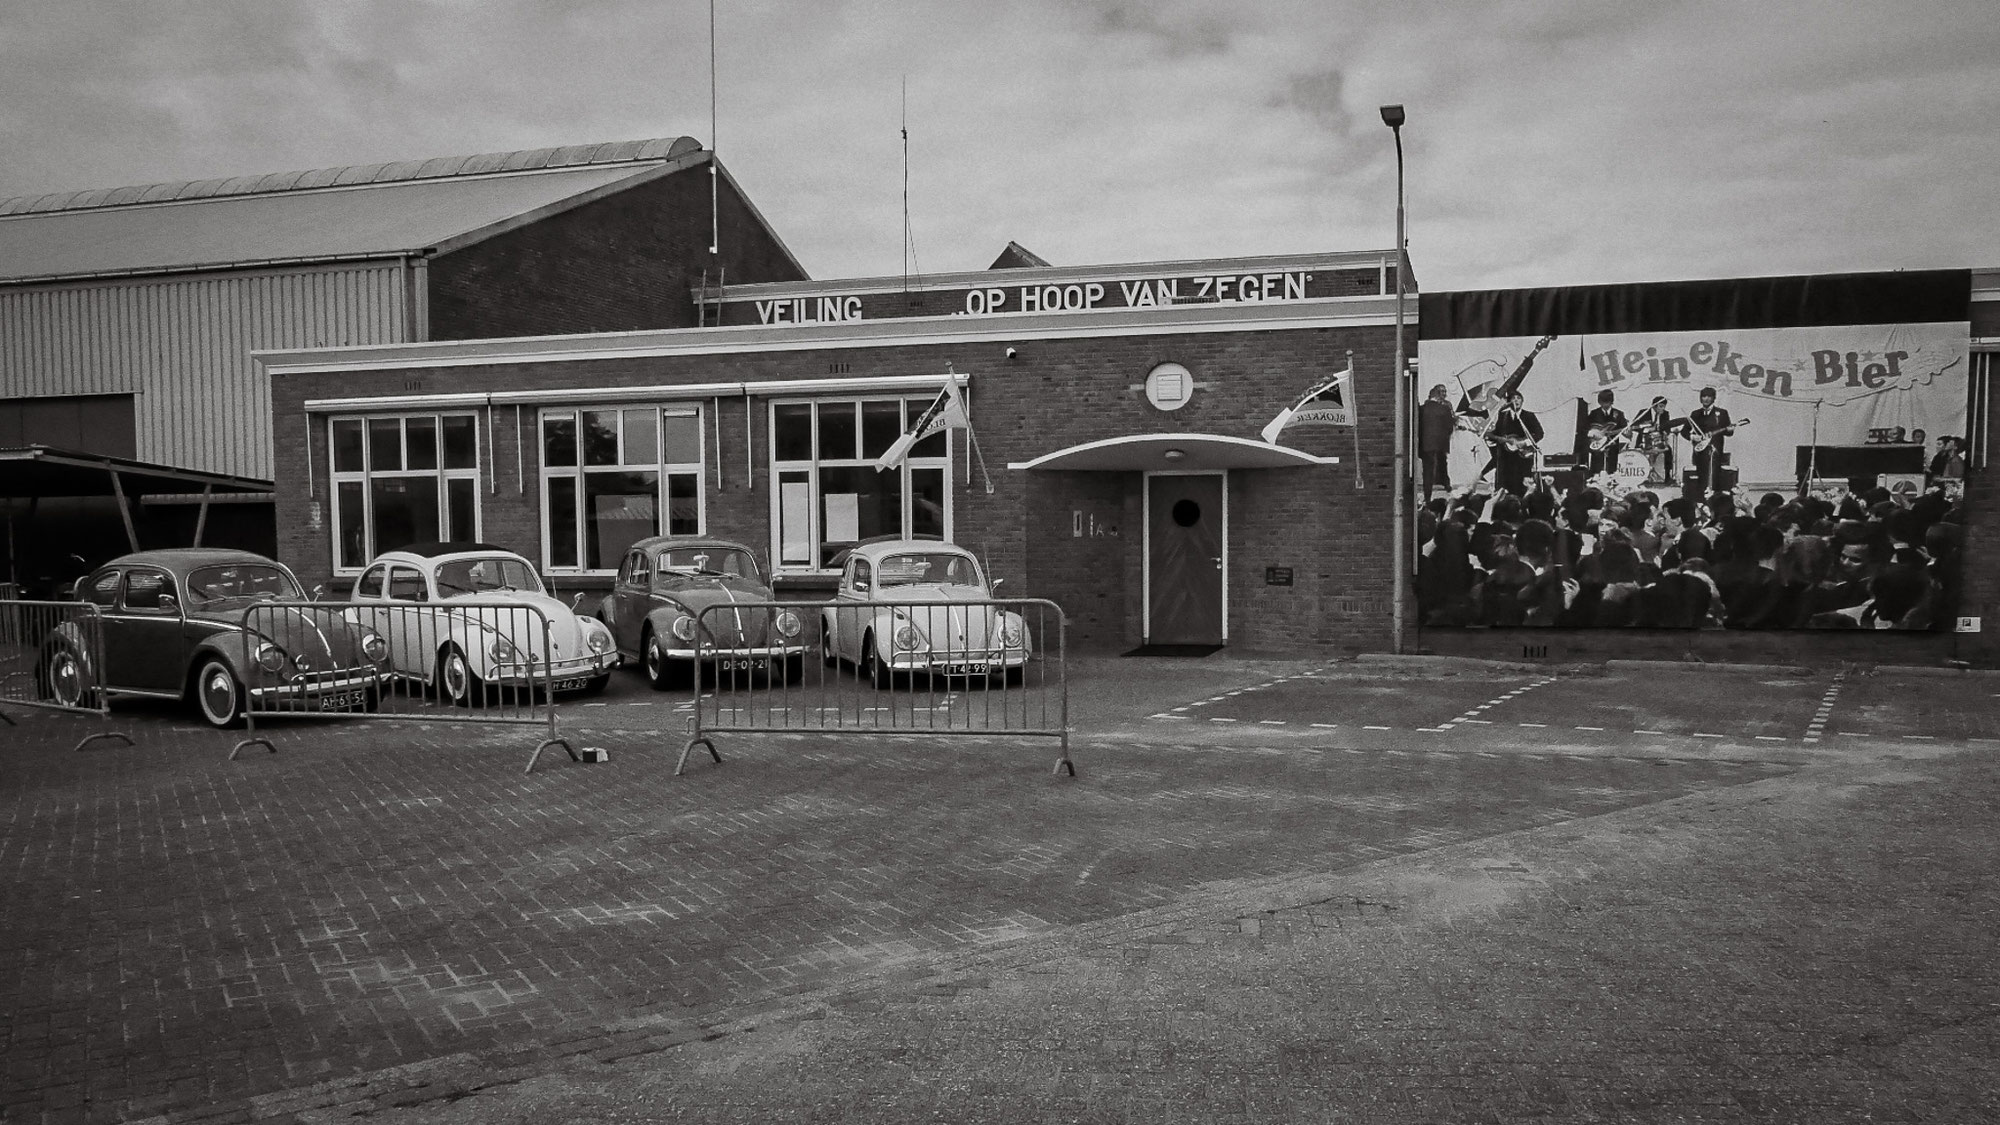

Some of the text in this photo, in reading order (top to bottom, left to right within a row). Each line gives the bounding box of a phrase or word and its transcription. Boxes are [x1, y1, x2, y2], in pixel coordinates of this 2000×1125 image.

[755, 296, 863, 325] VEILING
[1021, 283, 1105, 313] HOOP
[1119, 278, 1178, 308] VAN
[1591, 341, 1909, 397] Heineken Bier
